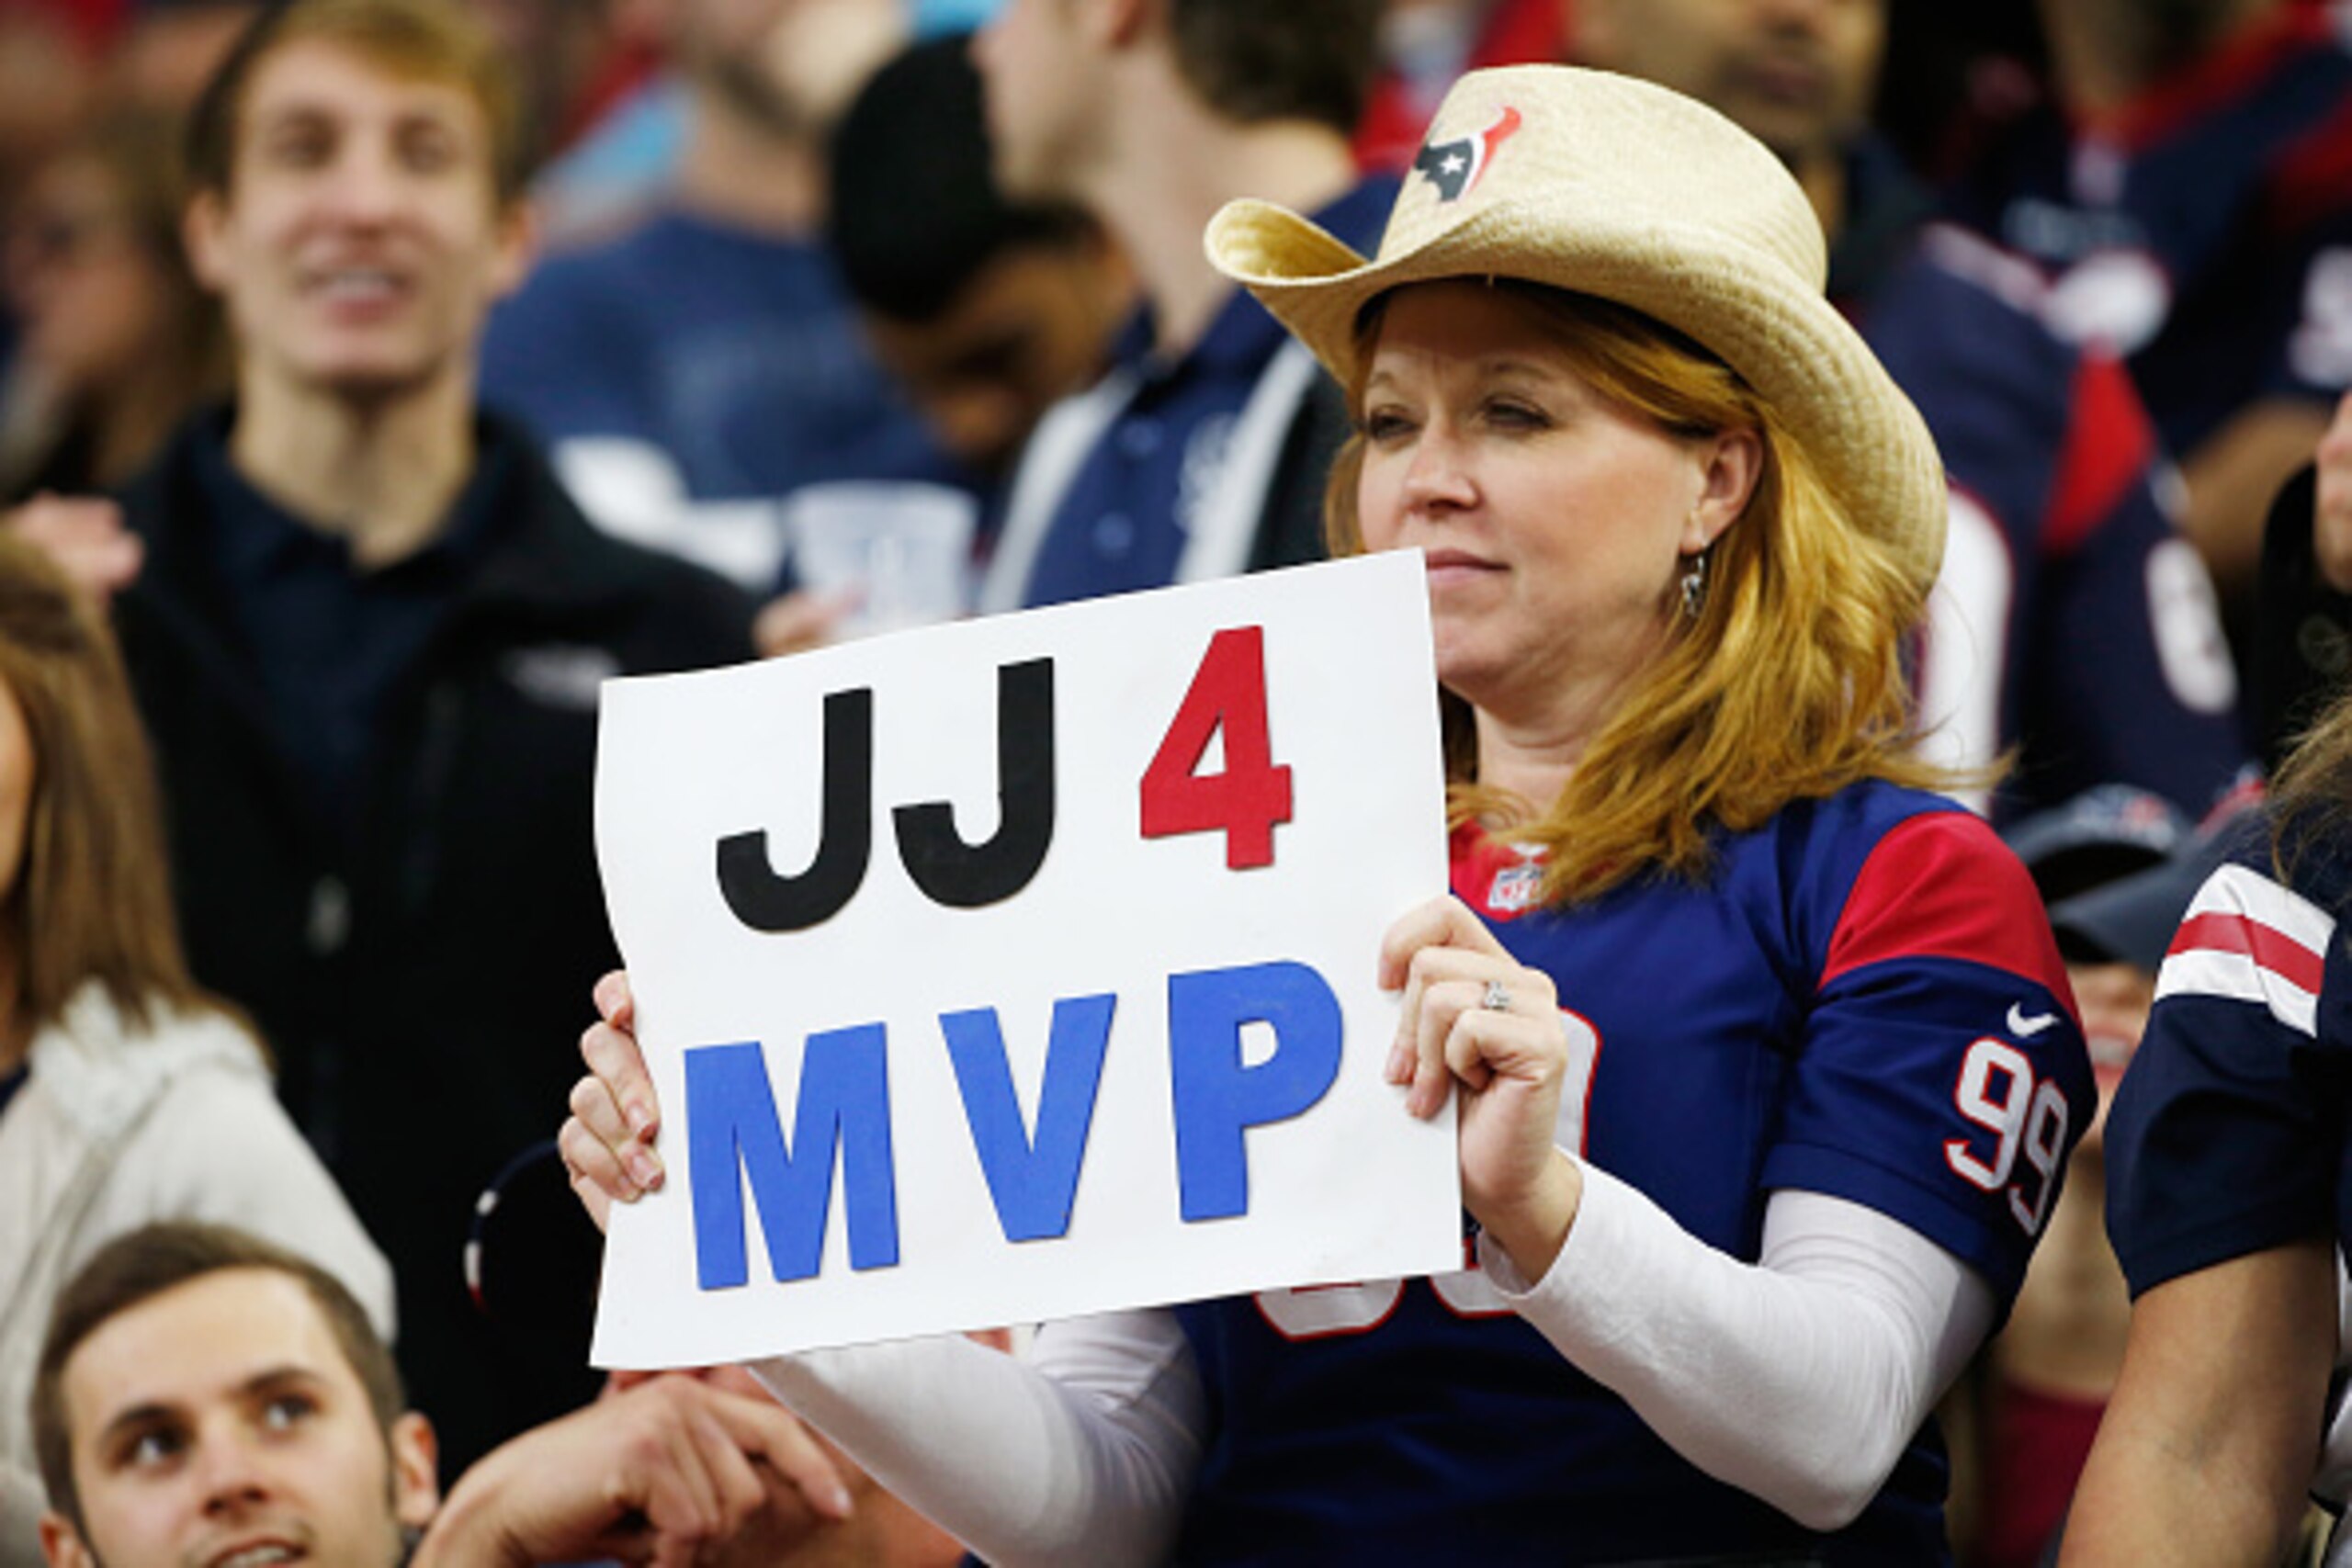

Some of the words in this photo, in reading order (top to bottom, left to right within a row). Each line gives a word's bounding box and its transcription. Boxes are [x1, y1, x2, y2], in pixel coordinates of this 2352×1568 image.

[716, 656, 1056, 933] JJ
[1139, 624, 1295, 871] 4
[683, 960, 1344, 1291] MVP
[1943, 1036, 2068, 1236] 99
